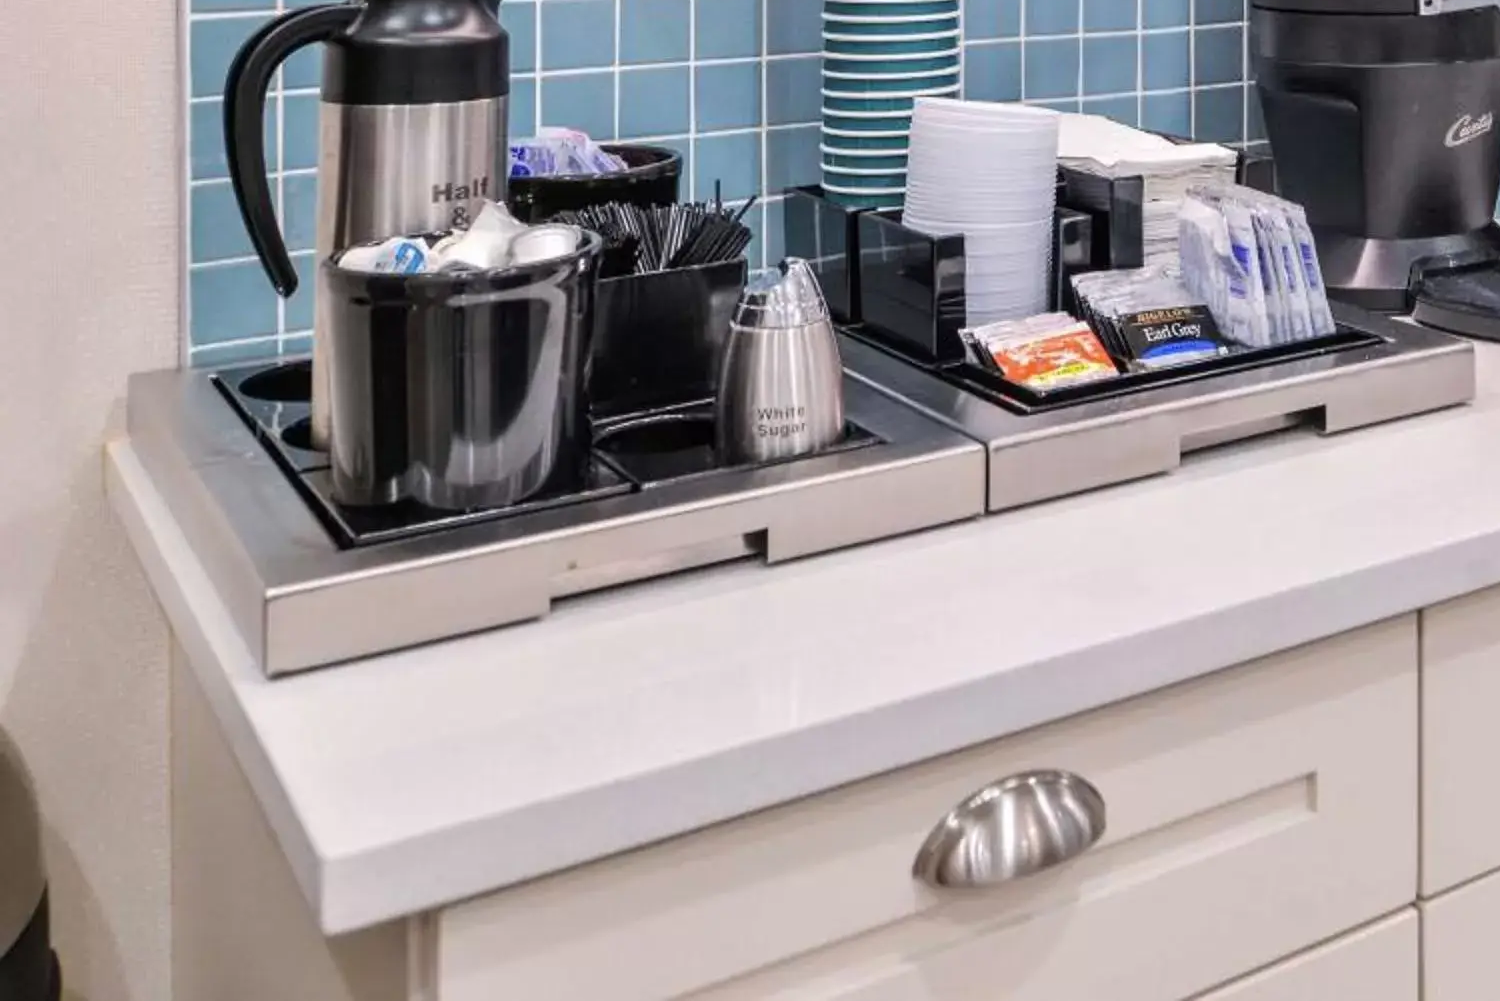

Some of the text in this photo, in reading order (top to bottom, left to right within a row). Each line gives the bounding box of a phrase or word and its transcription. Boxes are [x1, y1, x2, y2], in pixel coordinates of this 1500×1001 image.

[432, 177, 488, 203] Half
[452, 206, 471, 231] &
[1143, 322, 1201, 342] Earl Grey
[757, 406, 805, 420] White
[758, 422, 807, 438] Sugar
